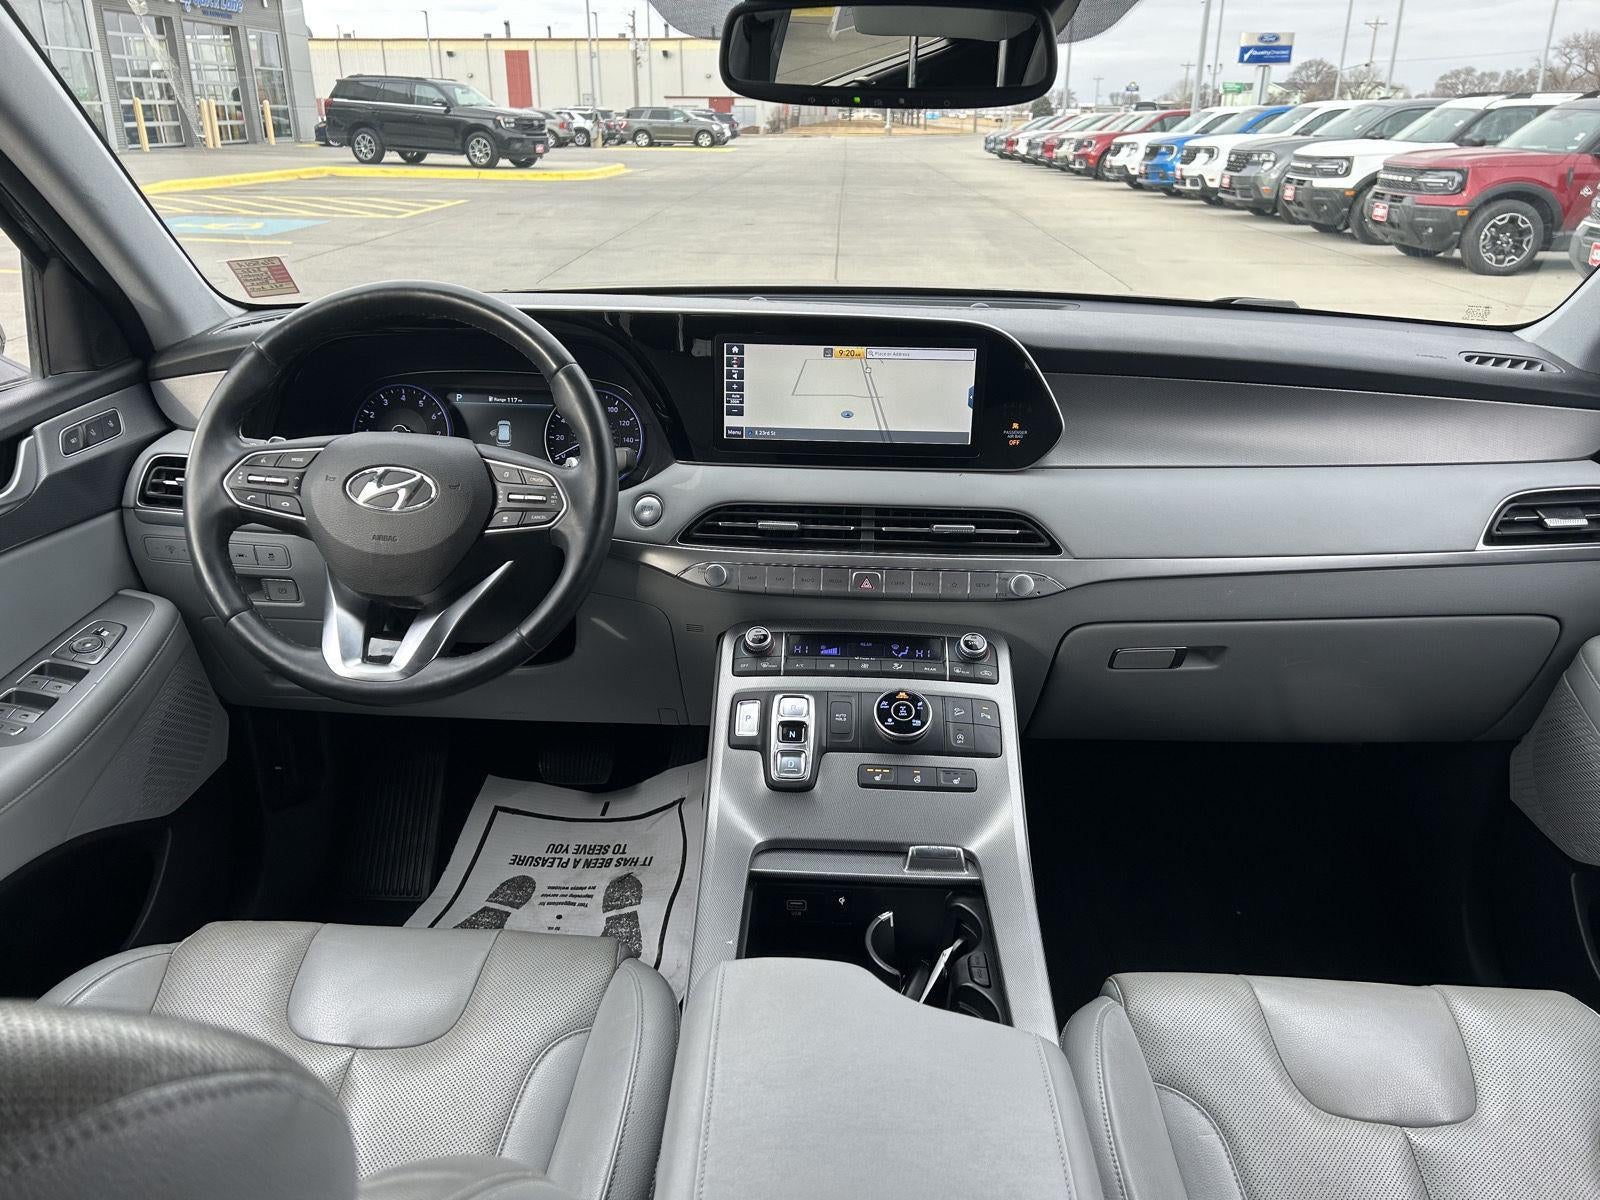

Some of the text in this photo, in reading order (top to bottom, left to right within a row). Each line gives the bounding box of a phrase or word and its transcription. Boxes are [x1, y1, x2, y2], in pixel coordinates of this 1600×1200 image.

[838, 349, 855, 357] 9:20
[456, 393, 463, 402] P
[431, 412, 437, 420] 6
[789, 730, 796, 738] N
[787, 760, 795, 768] D
[545, 843, 627, 855] TO SERVE YOU
[508, 854, 654, 869] IT HAS BEEN A PLEASURE
